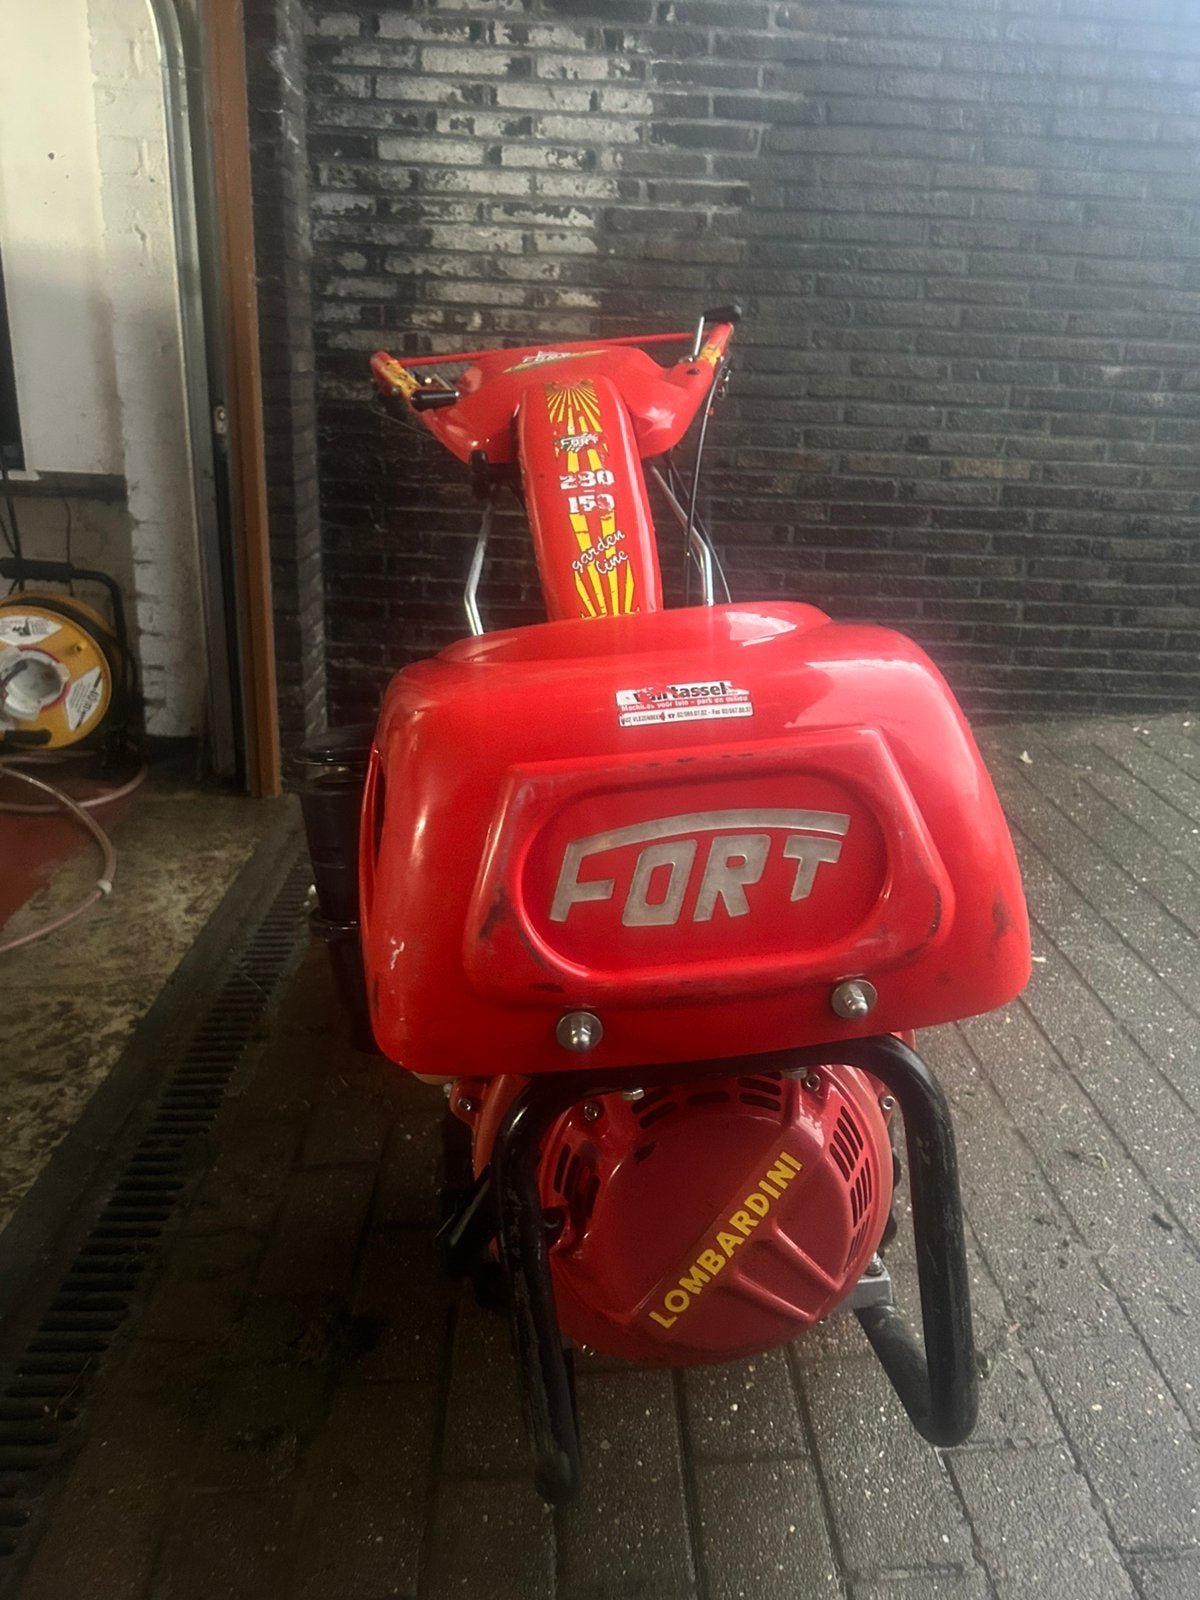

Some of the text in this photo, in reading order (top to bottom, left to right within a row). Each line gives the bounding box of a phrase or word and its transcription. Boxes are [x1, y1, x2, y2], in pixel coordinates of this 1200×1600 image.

[572, 530, 625, 574] garden
[549, 808, 851, 928] FORT
[649, 1151, 802, 1329] LOMBARDINI
